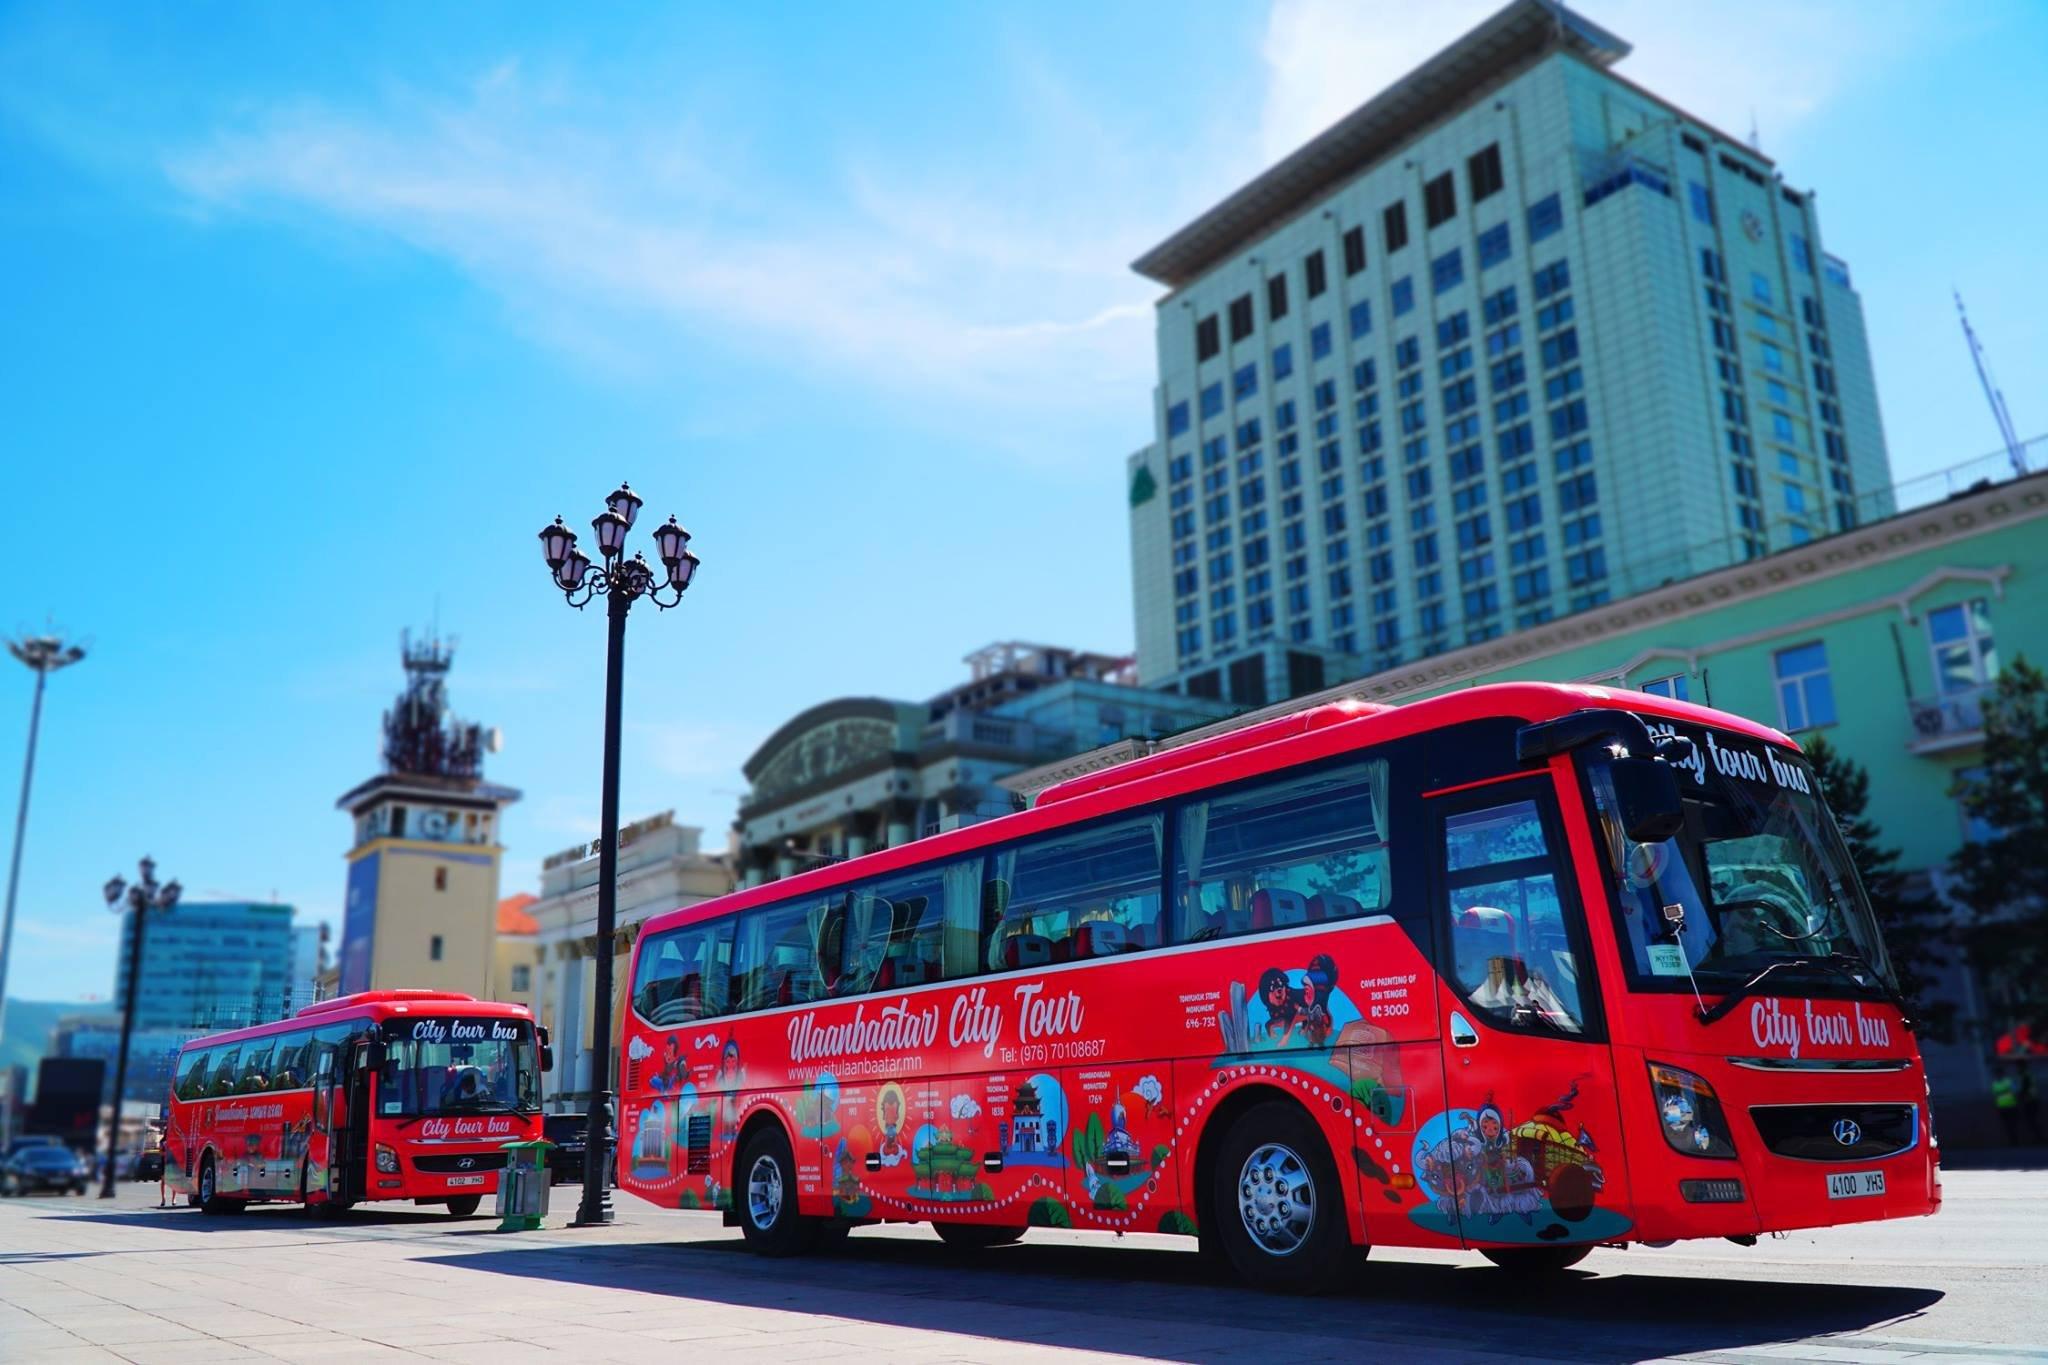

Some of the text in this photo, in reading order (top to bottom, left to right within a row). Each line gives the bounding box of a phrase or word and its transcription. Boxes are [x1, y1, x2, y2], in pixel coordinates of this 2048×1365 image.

[1706, 731, 1767, 783] tour
[1765, 744, 1810, 795] bus
[1360, 973, 1417, 989] CAVE PAINTING OF
[1383, 988, 1408, 999] TENGER
[787, 980, 1085, 1063] Ulaanbaatar City Tour
[1371, 1003, 1410, 1018] BC 3000
[412, 1019, 518, 1043] City tour bus
[1185, 1016, 1217, 1029] 646-732
[1751, 998, 1890, 1060] City tour bus
[1000, 1039, 1106, 1066] Tel: (976) 70108687
[787, 1055, 923, 1082] www.visitulaanbaatar.mn
[422, 1116, 510, 1139] City tour bus
[1832, 1175, 1857, 1196] 4100
